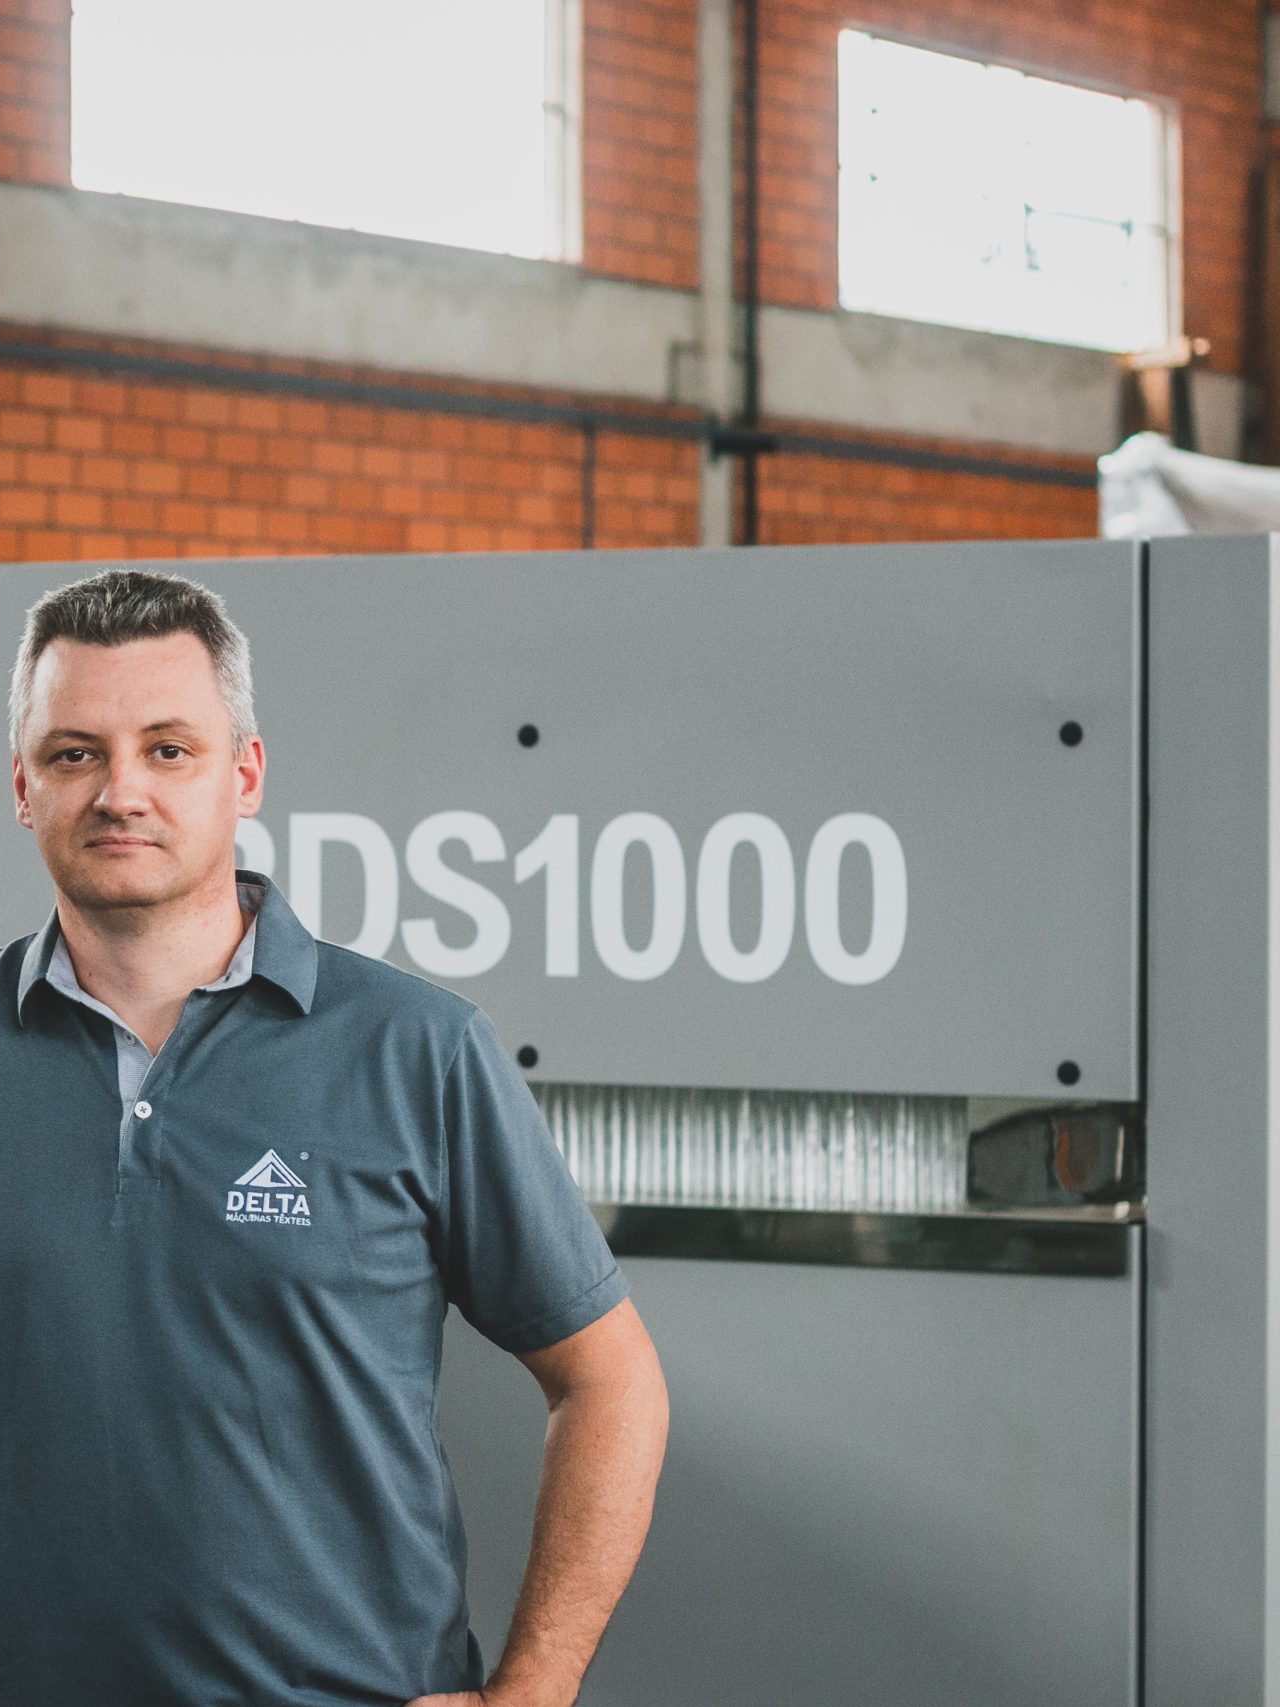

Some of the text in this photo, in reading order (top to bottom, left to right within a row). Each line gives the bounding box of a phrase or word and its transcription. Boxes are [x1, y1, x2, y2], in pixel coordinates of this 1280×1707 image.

[226, 1191, 311, 1216] DELTA
[225, 1212, 312, 1227] MÁQUINAS TÊXTEIS
